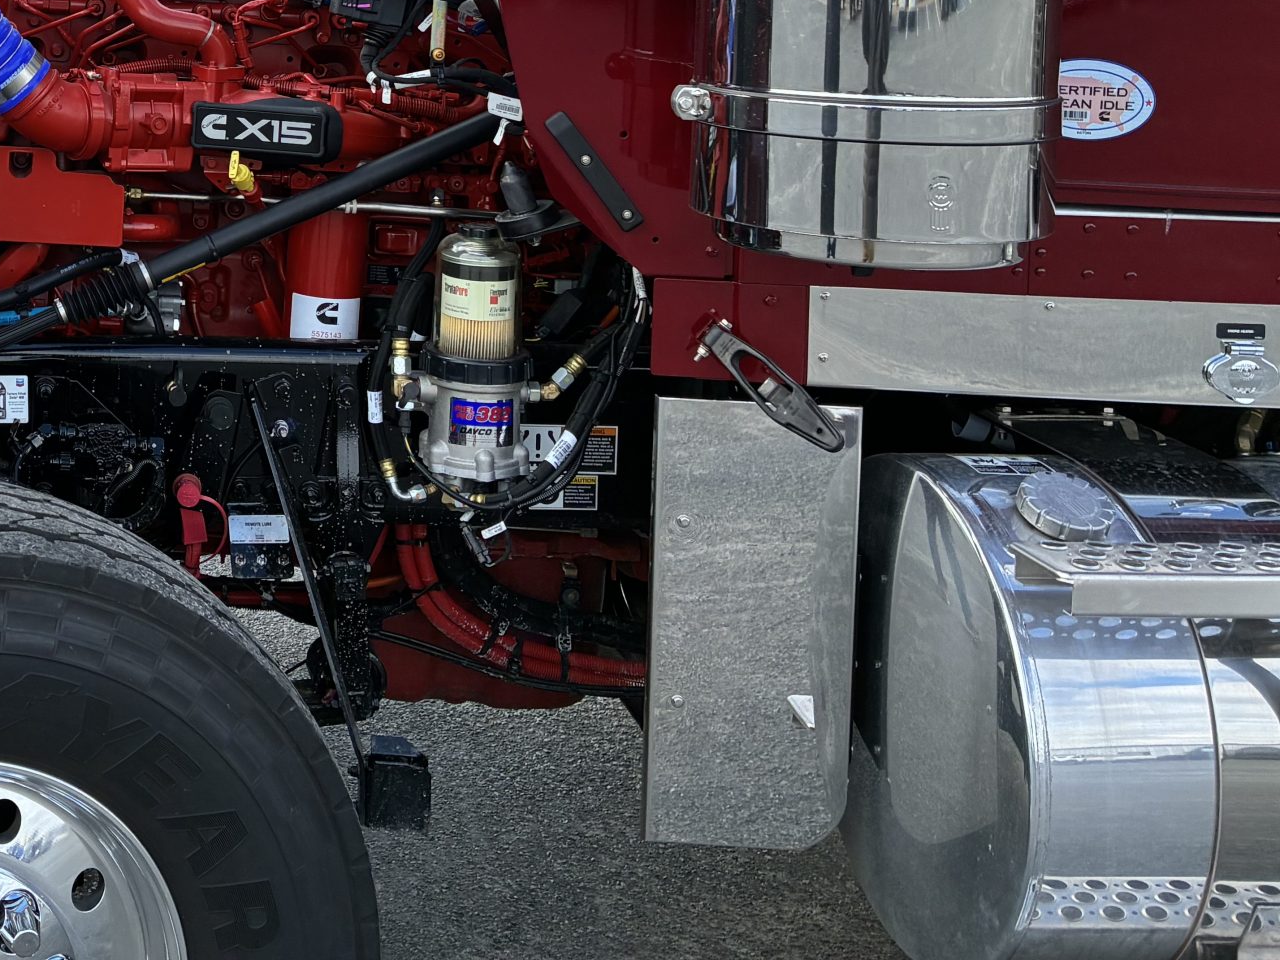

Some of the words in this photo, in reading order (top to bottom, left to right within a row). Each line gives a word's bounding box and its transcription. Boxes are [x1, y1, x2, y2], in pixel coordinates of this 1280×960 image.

[1060, 85, 1128, 98] ERTIFIED
[1062, 99, 1092, 109] EAN
[1100, 100, 1135, 111] IDLE
[234, 117, 313, 146] X15
[311, 330, 342, 339] 5575143
[460, 427, 493, 436] DAYCO
